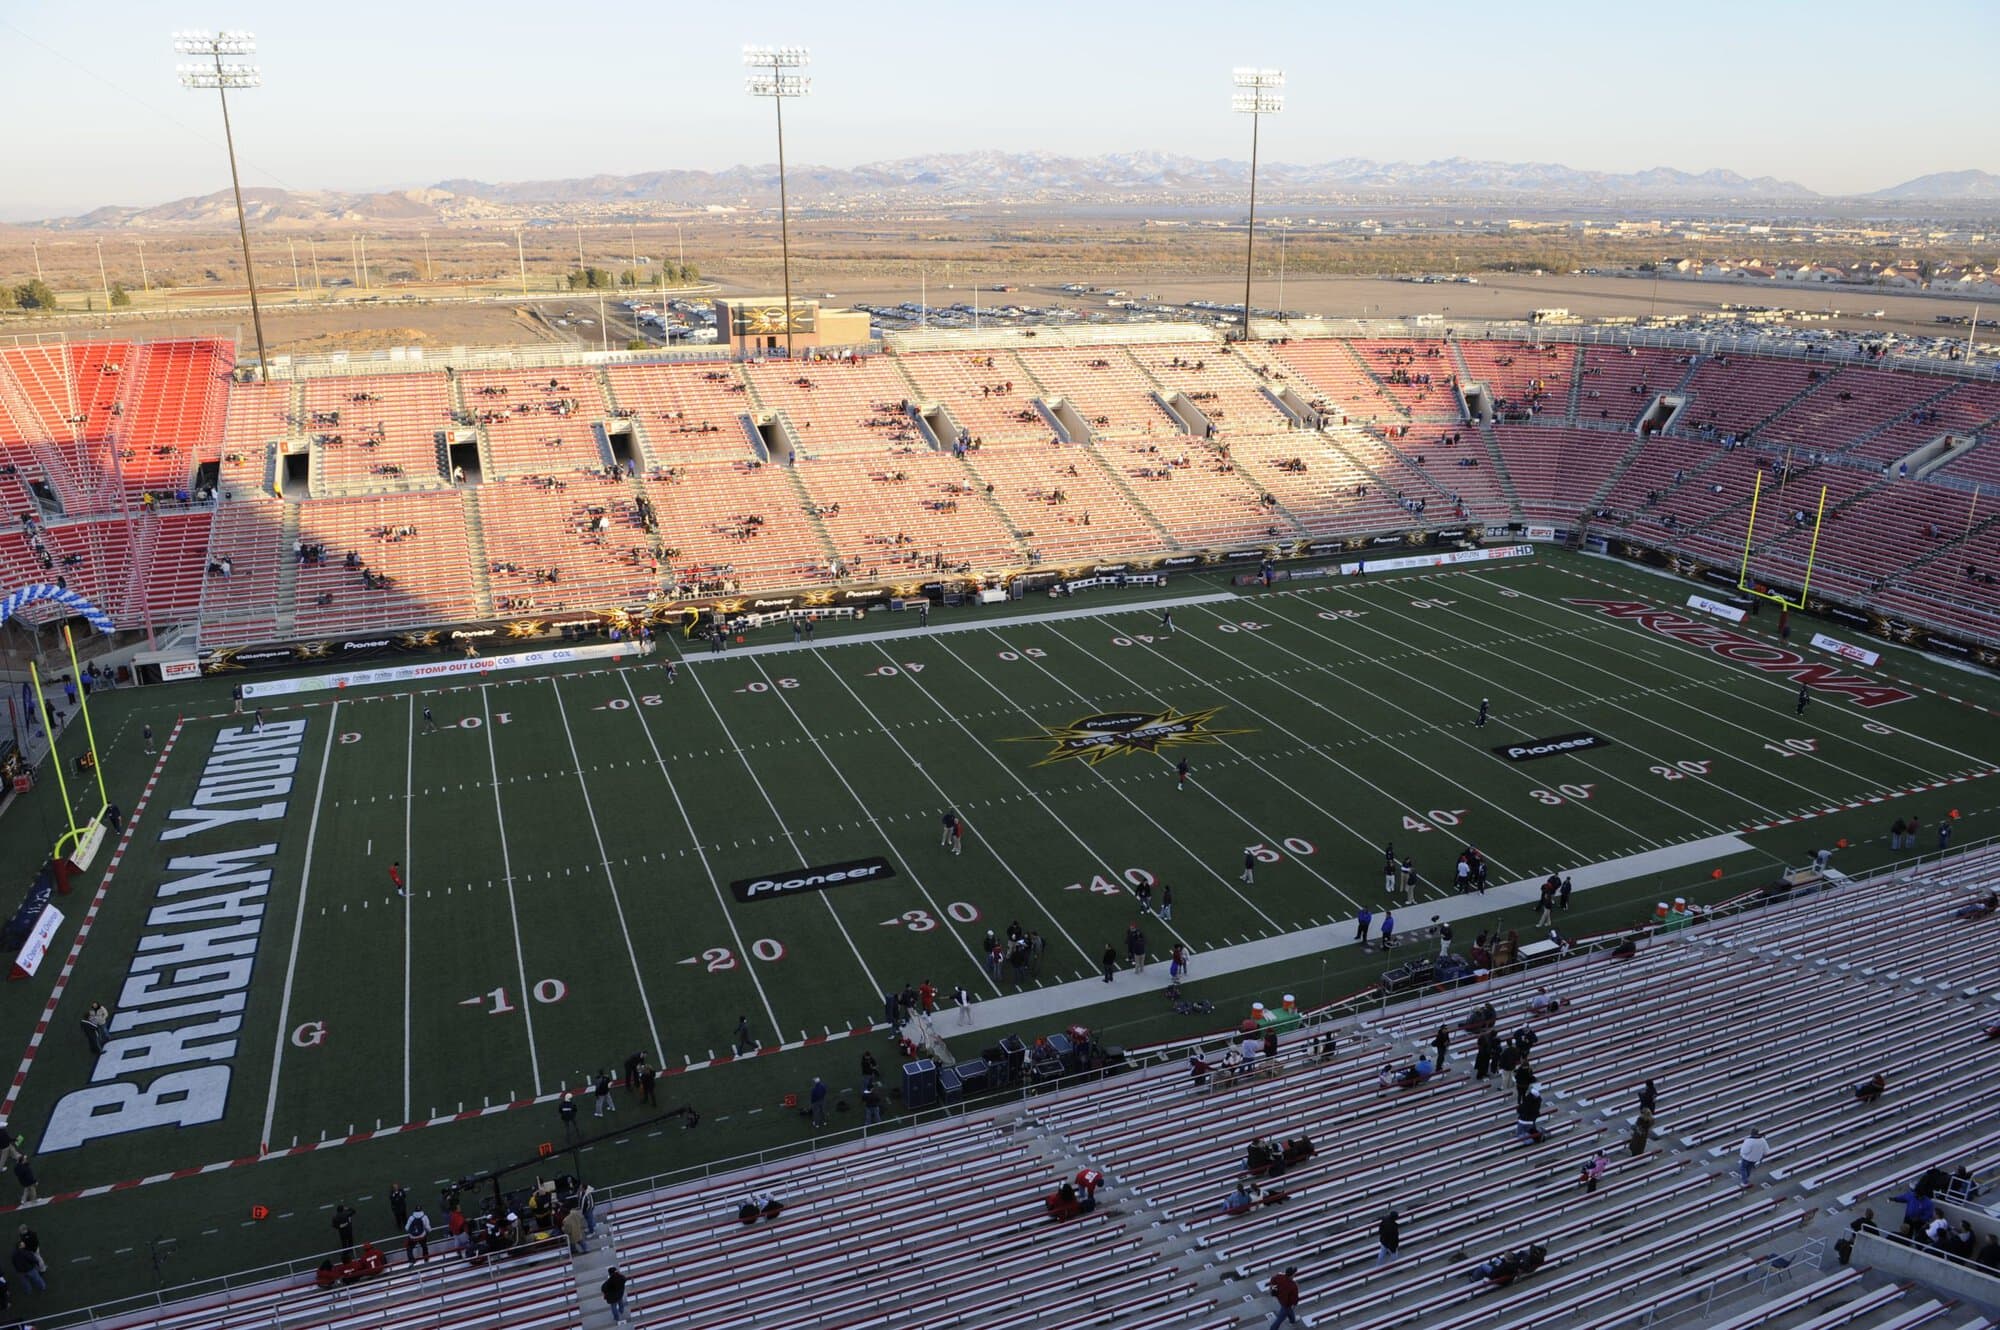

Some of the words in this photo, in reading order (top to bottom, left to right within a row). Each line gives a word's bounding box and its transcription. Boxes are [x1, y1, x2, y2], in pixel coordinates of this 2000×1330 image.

[755, 598, 794, 608] Pioneer
[846, 589, 883, 598] Pioneer
[451, 629, 496, 639] Pioneer
[344, 639, 390, 650] Pioneer
[1560, 597, 1918, 710] ARIZONA
[166, 663, 196, 674] ESPN
[415, 663, 447, 676] STOMP
[449, 660, 468, 672] OUT
[470, 659, 495, 670] LOUD
[1086, 716, 1143, 729] Pioneer
[1071, 735, 1114, 748] LAS
[1118, 723, 1187, 740] VEGAS
[1507, 735, 1595, 759] Pioneer
[159, 719, 308, 841] YOUNG
[747, 865, 882, 897] Pioneer
[39, 843, 279, 1154] BRIGHAM
[291, 1020, 327, 1048] G
